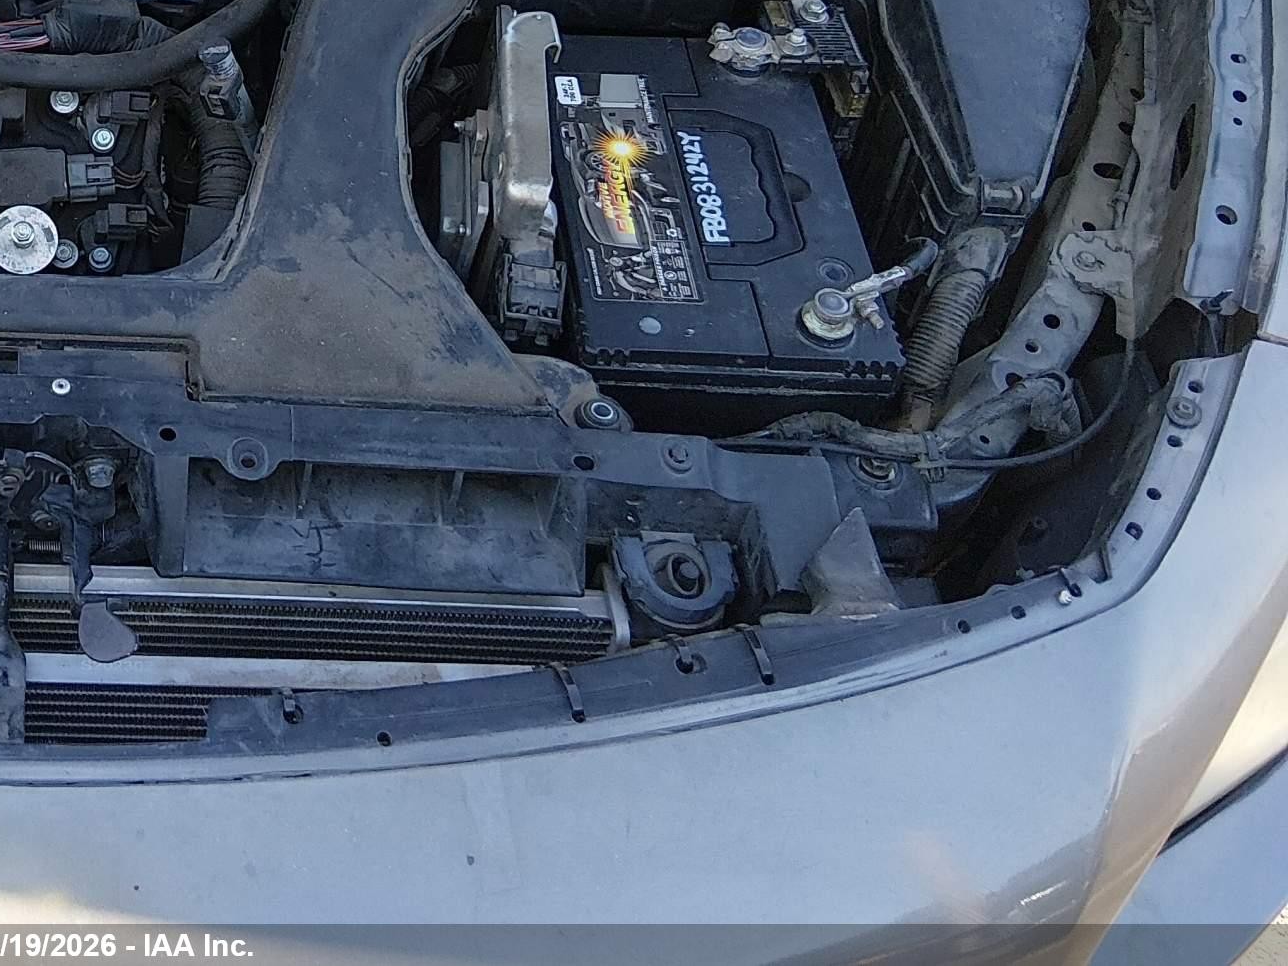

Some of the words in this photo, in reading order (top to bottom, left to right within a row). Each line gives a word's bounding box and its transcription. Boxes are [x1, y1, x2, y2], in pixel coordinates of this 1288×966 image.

[566, 79, 575, 92] CCA
[598, 182, 615, 219] MOTIVE
[603, 160, 636, 235] ENERGY
